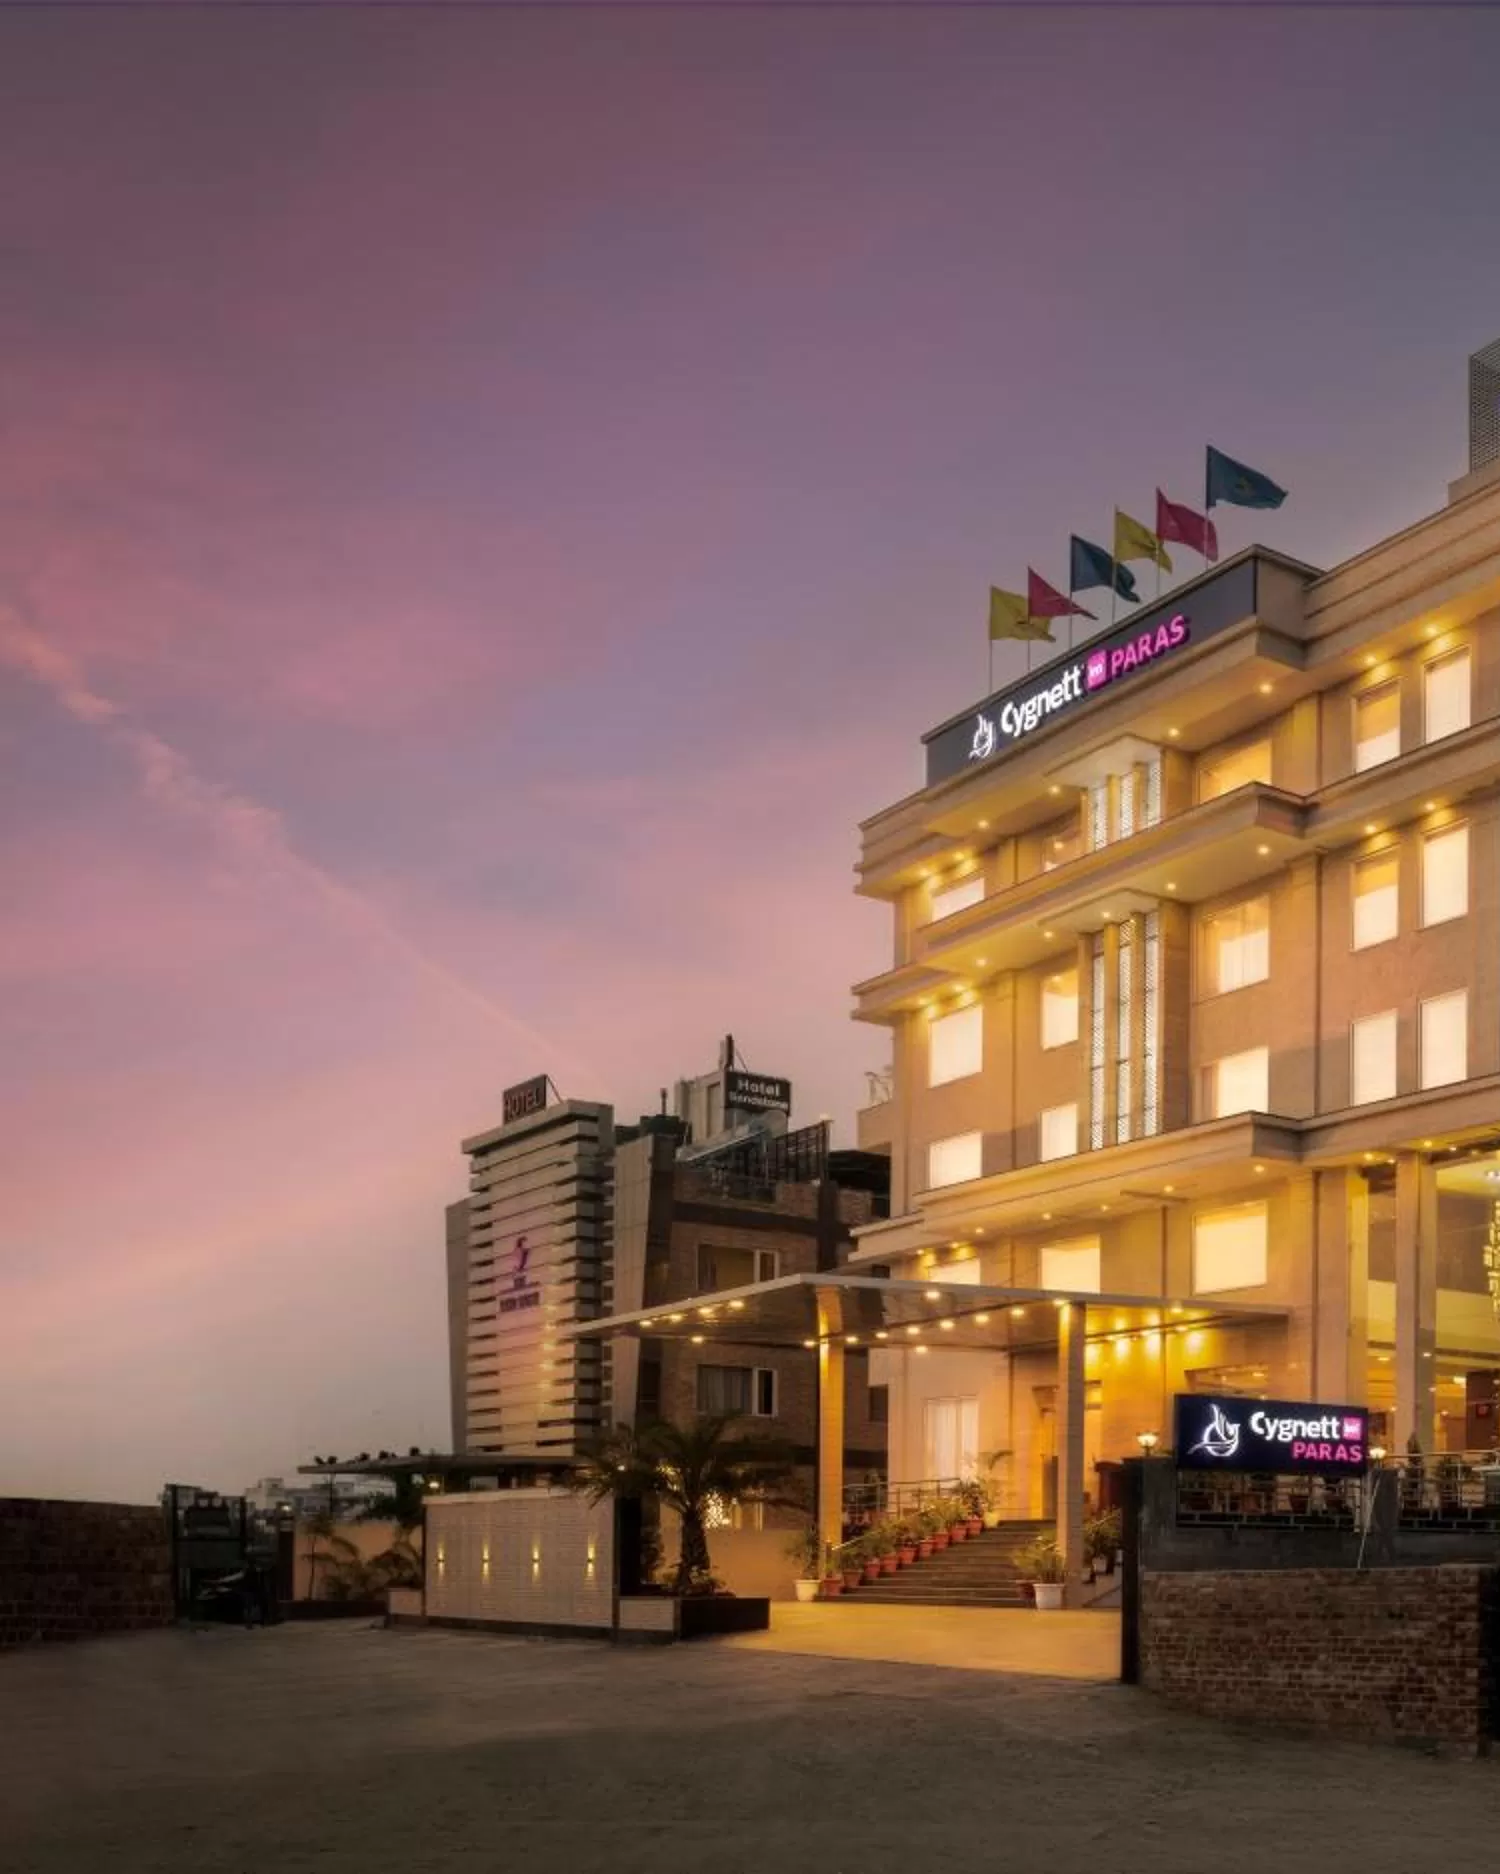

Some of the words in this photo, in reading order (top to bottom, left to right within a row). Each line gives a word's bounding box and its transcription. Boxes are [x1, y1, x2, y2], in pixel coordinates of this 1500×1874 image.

[1000, 665, 1082, 737] Cygnett
[1111, 614, 1186, 676] PARAS
[1250, 1411, 1340, 1442] Cygnett
[1292, 1441, 1362, 1463] PARAS
